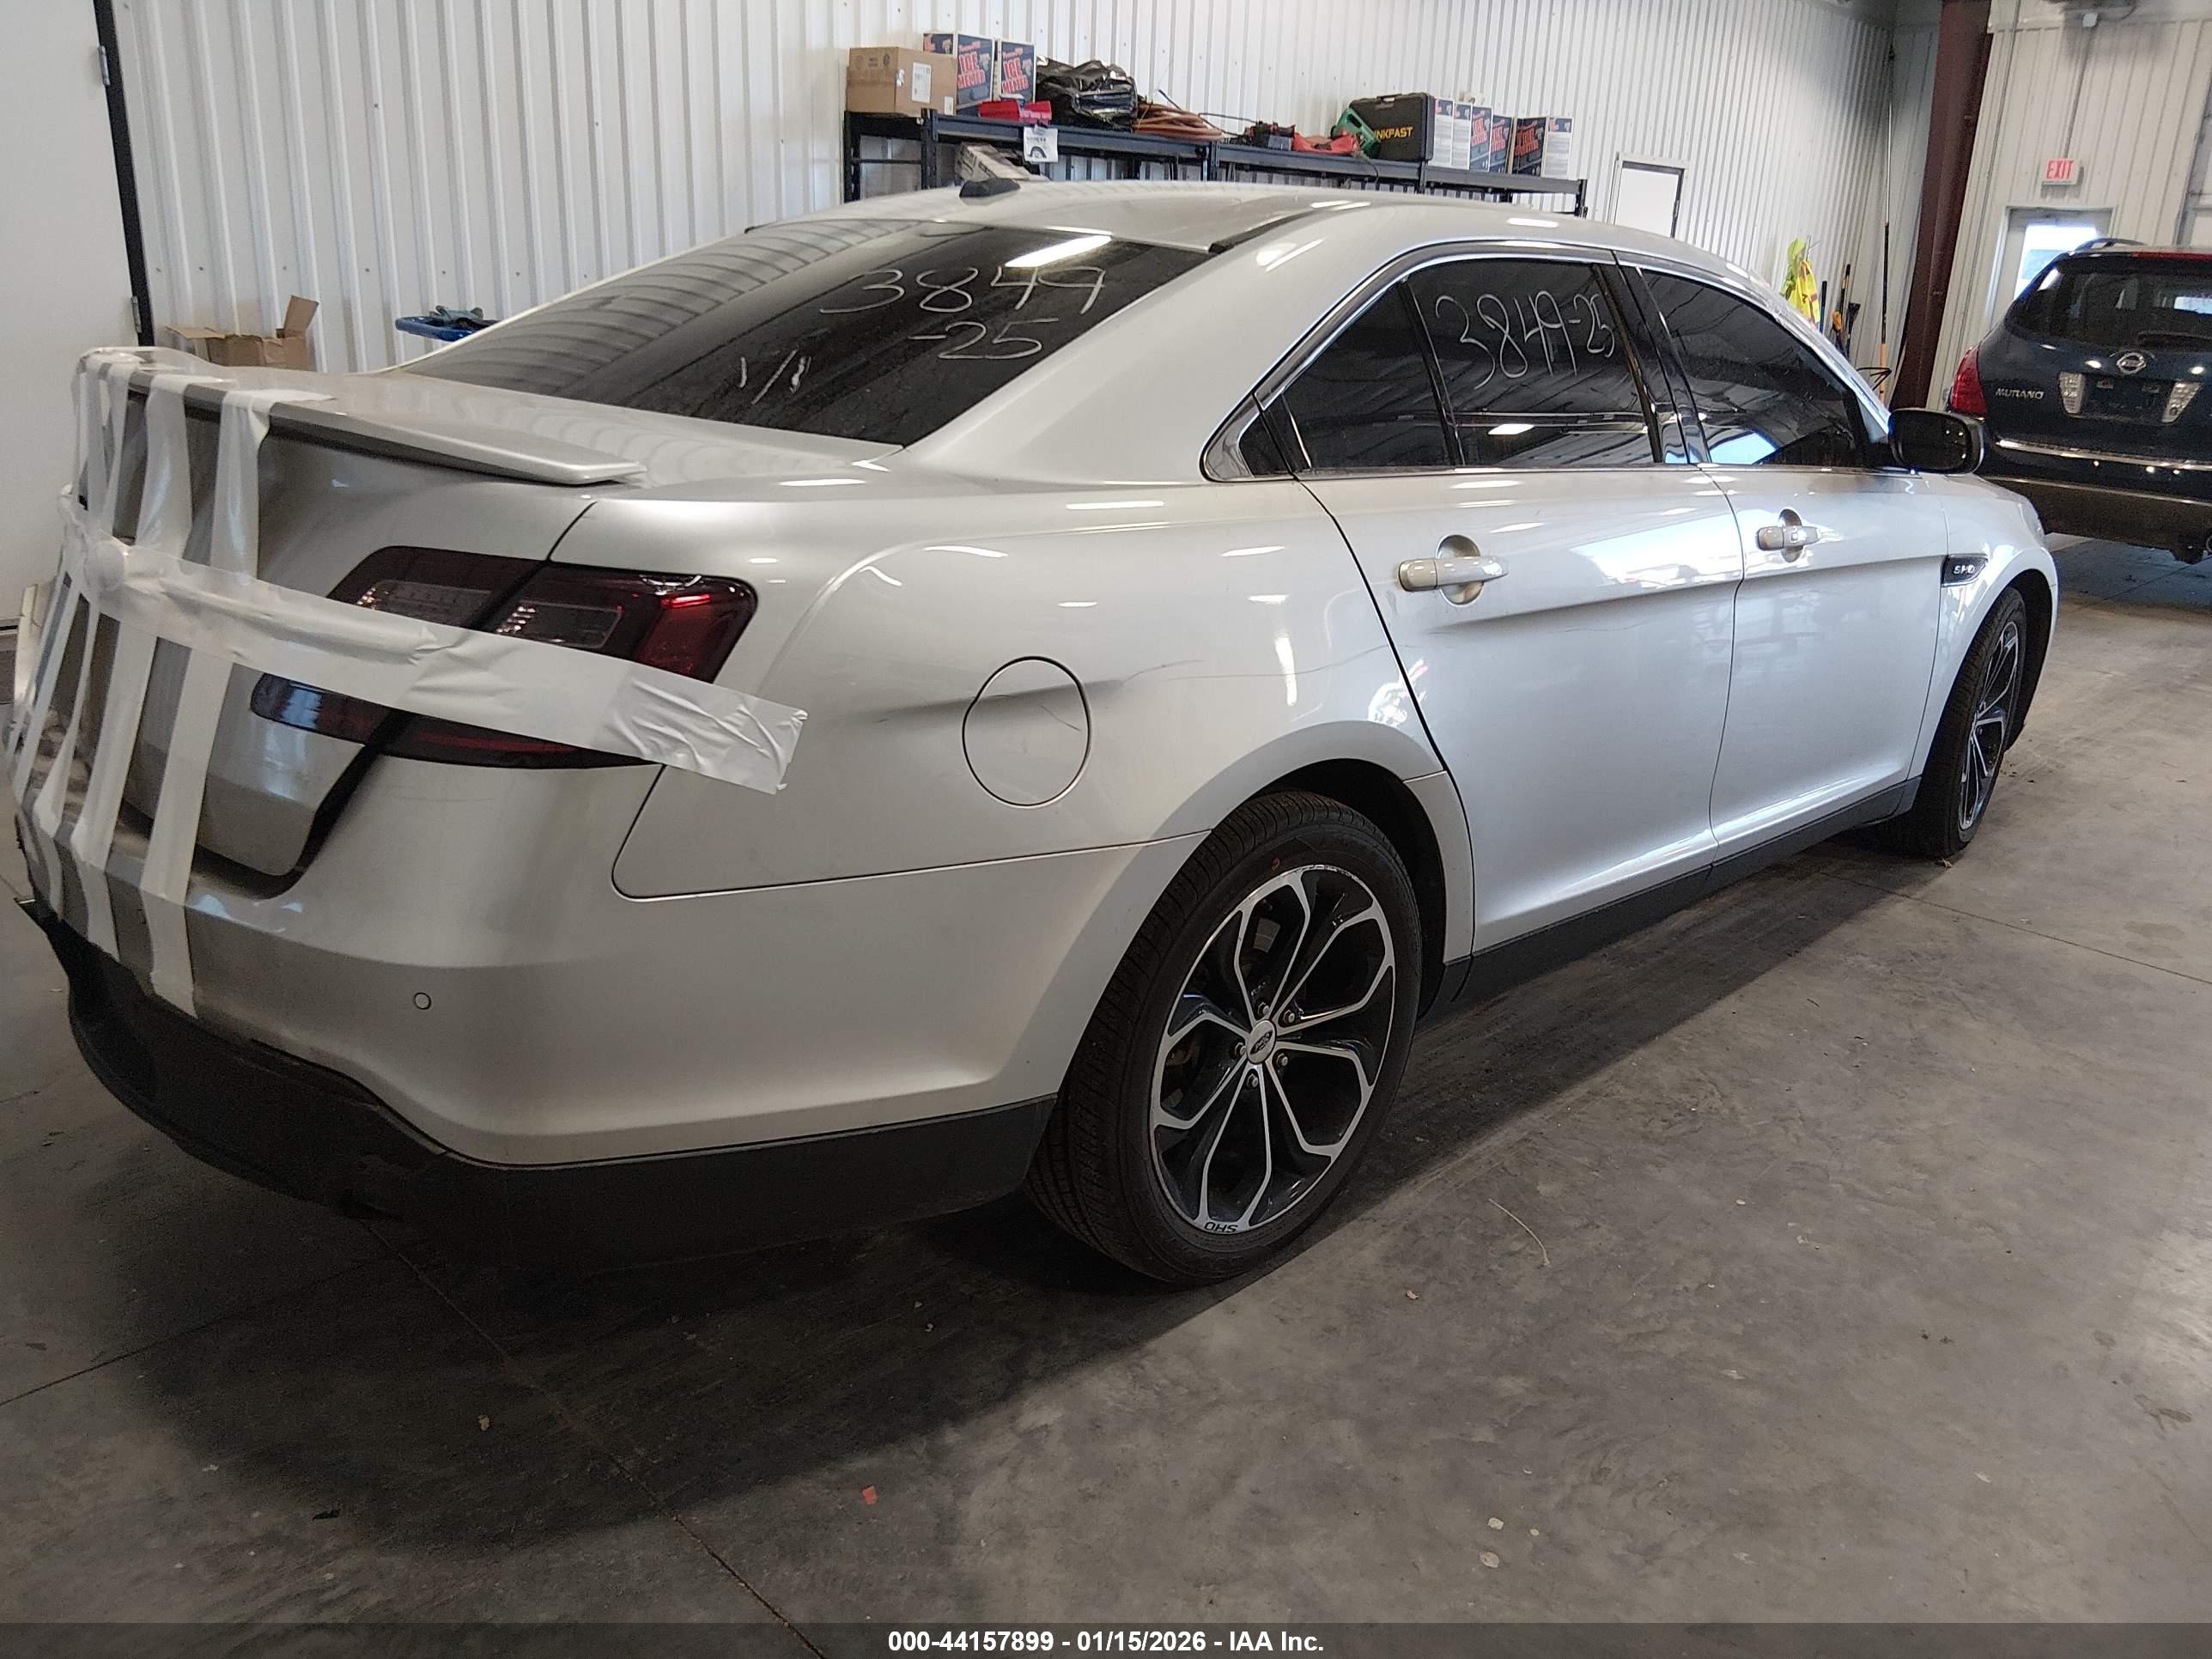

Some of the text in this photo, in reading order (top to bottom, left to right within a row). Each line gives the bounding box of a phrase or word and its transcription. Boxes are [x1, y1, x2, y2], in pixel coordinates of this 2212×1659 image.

[2046, 160, 2074, 179] EXIT
[818, 267, 1107, 315] 3849
[1995, 387, 2045, 400] MURANO
[1204, 1221, 1238, 1233] SHO
